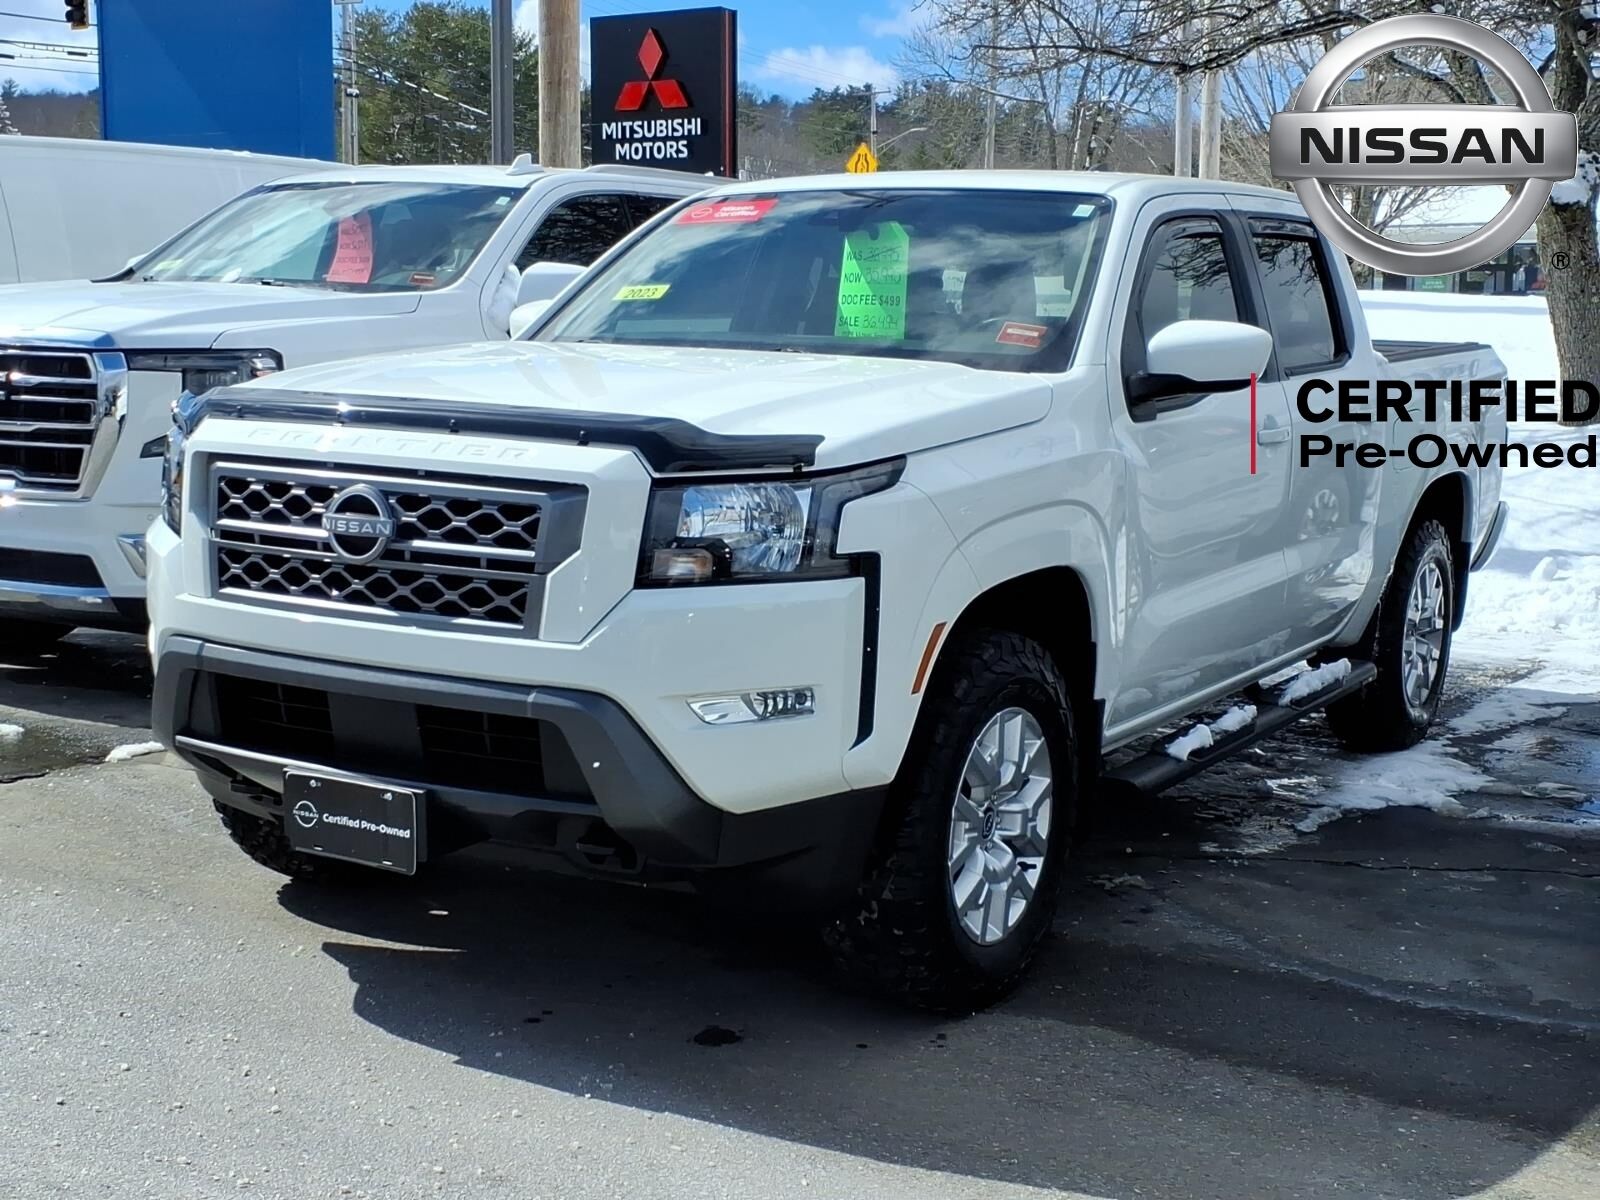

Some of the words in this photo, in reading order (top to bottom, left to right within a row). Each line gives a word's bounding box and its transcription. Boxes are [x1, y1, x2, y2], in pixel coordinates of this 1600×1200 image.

[602, 117, 701, 140] MITSUBISHI
[615, 140, 688, 160] MOTORS
[844, 272, 862, 283] NOW
[624, 287, 658, 298] 2023
[841, 294, 860, 305] DOC
[859, 294, 877, 305] FEE
[878, 295, 901, 306] $499
[838, 316, 860, 327] SALE
[322, 518, 390, 534] NISSAN
[322, 813, 360, 828] Certified
[361, 820, 411, 838] Pre-Owned
